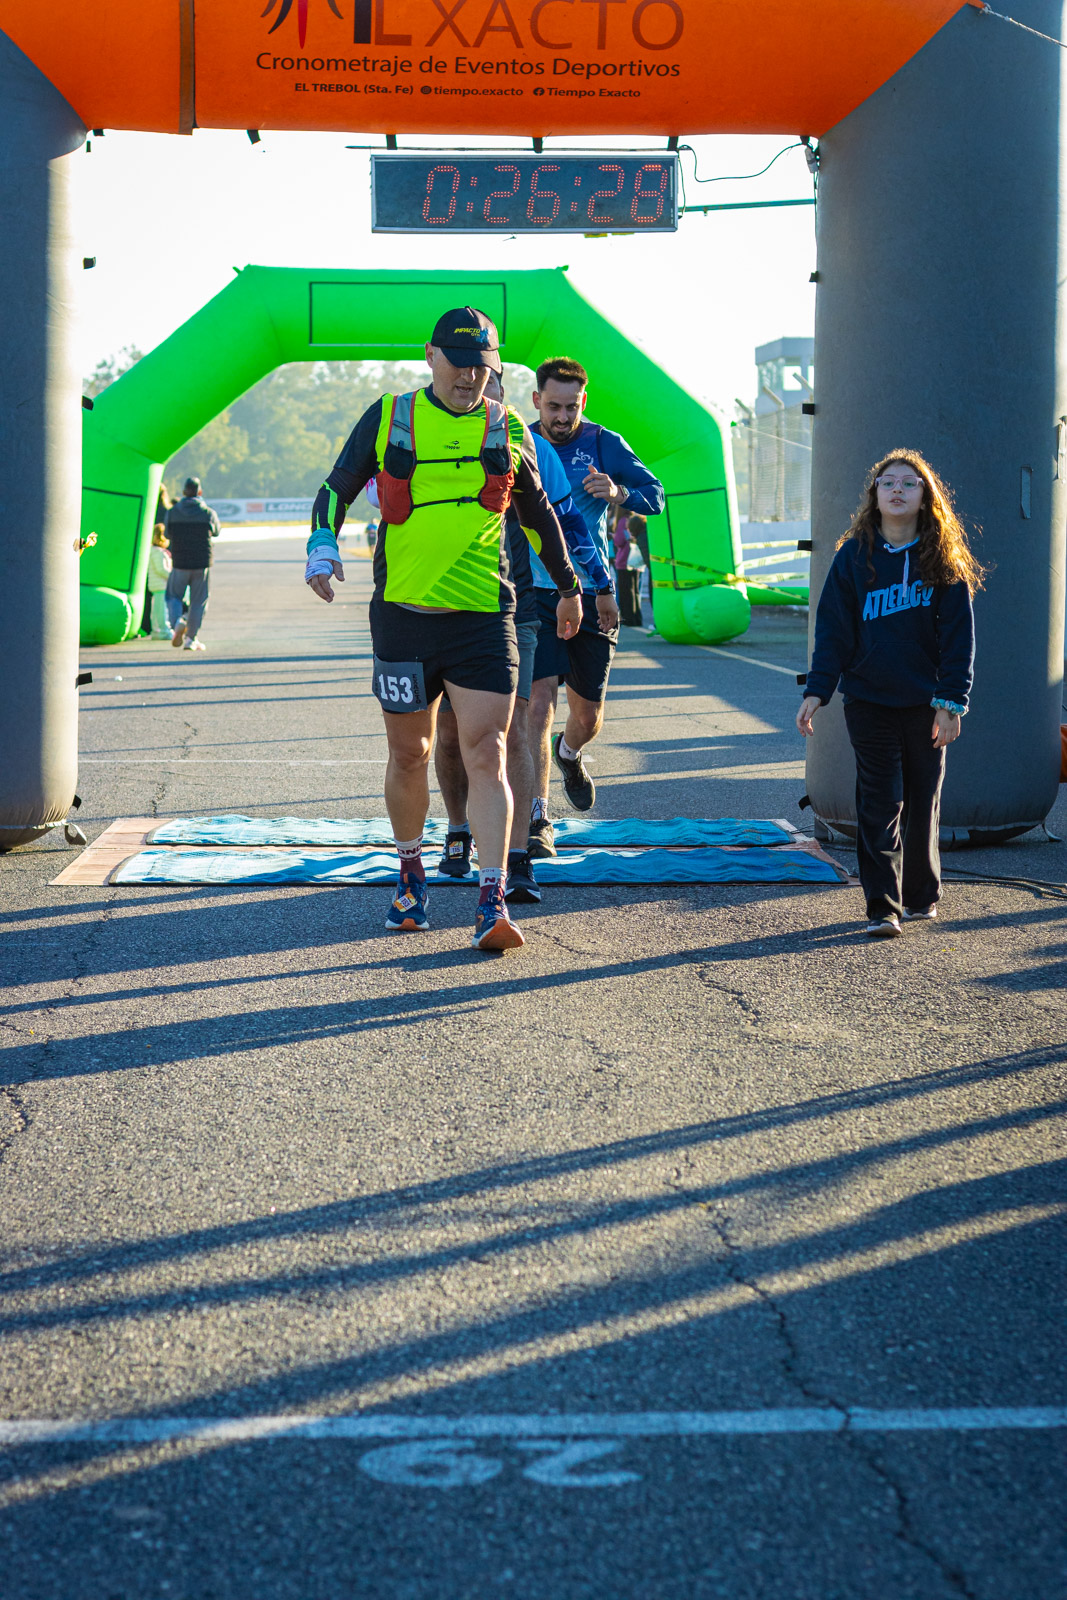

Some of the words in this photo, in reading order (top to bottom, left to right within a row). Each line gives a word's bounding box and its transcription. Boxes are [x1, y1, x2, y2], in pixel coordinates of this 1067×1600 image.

[256, 52, 413, 77] Cronometraje
[418, 55, 448, 74] de
[454, 56, 545, 76] Eventos
[552, 58, 680, 80] Deportivos
[294, 83, 310, 92] EL
[311, 83, 361, 93] TREBOL
[363, 84, 393, 95] (Sta.
[394, 84, 414, 96] Fe)
[433, 86, 524, 97] tiempo.exacto
[547, 87, 596, 99] Tiempo
[598, 88, 641, 98] Exacto
[422, 164, 669, 224] 0:26:28
[378, 673, 414, 704] 153
